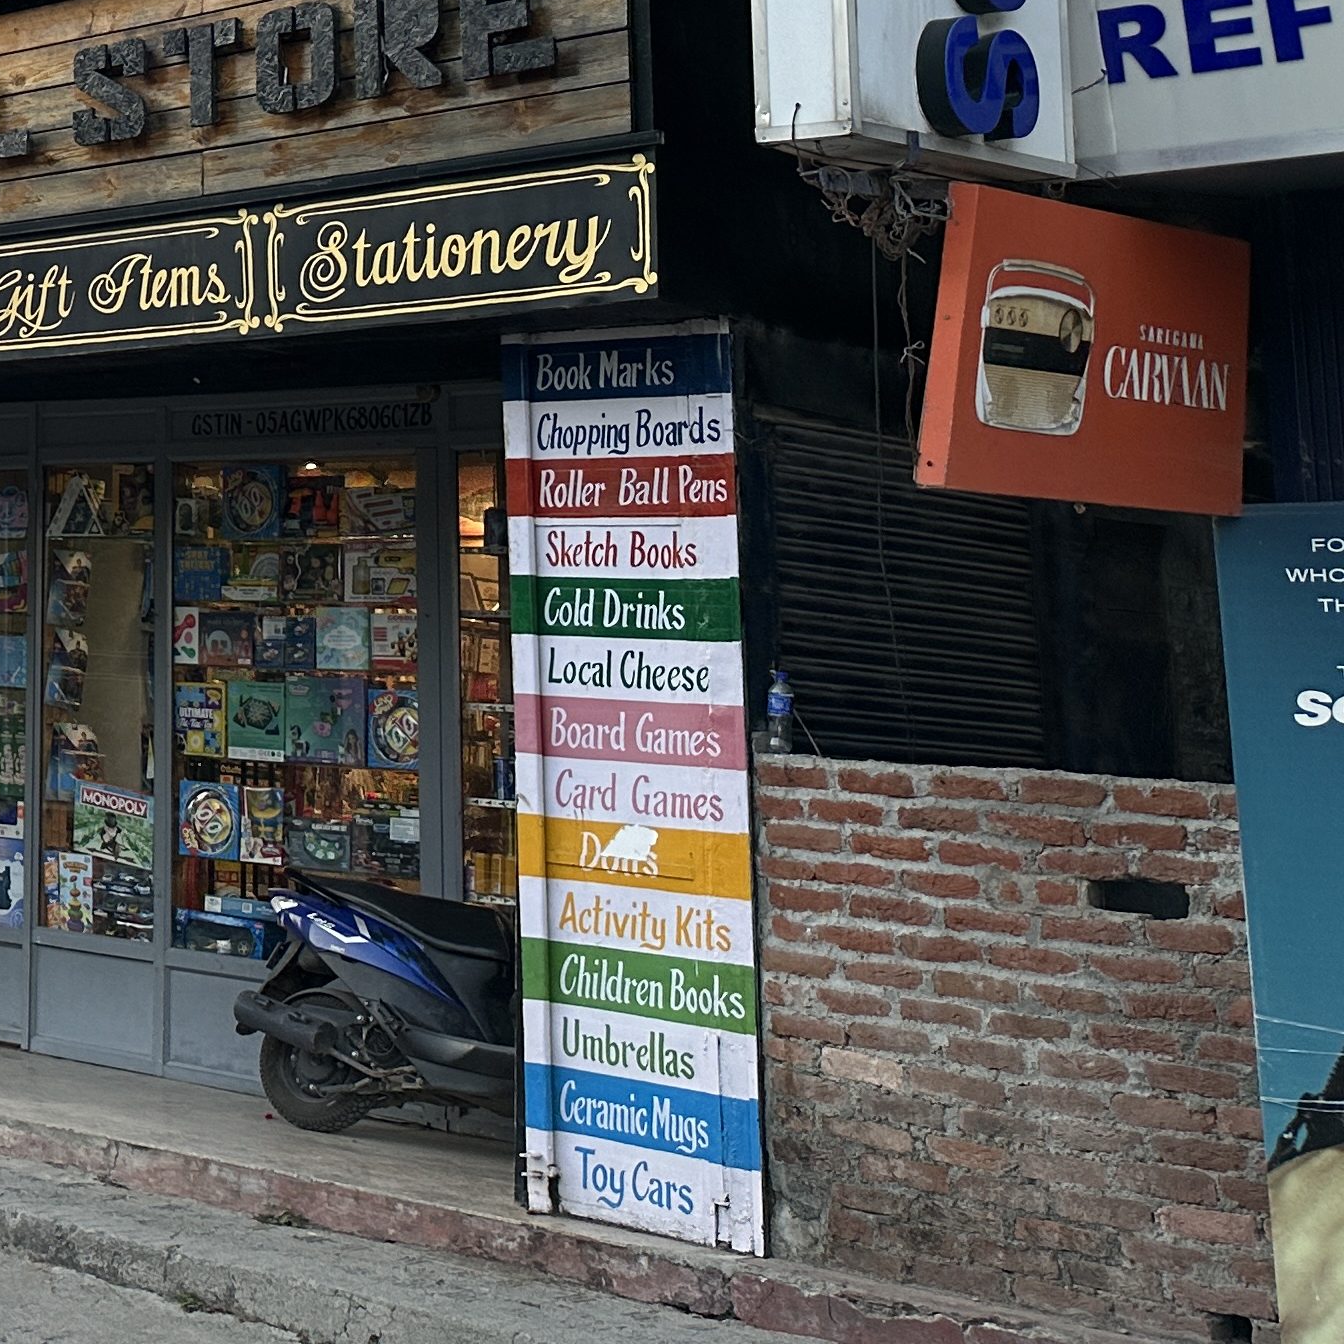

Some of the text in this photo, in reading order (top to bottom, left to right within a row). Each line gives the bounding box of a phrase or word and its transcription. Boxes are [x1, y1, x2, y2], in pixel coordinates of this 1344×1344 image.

[300, 213, 612, 303] Stationery
[88, 253, 232, 316] Items
[1139, 324, 1204, 351] SAREGAMA
[536, 348, 675, 391] Book Marks
[1103, 346, 1230, 411] CARVAAN
[191, 412, 243, 436] GSTIN
[537, 407, 721, 455] Chopping Boards
[539, 465, 728, 509] Roller Ball Pens
[546, 531, 697, 568] Sketch Books
[544, 587, 685, 631] Cold Drinks
[548, 647, 710, 692] Local Cheese
[551, 708, 722, 757] Board Games
[82, 789, 147, 817] MONOPOLY
[556, 769, 724, 822] Card Games
[559, 891, 732, 952] Activity Kits
[560, 953, 746, 1020] Children Books
[562, 1016, 695, 1080] Umbrellas
[560, 1080, 710, 1153] Ceramic Mugs
[574, 1145, 694, 1216] Toy Cars
